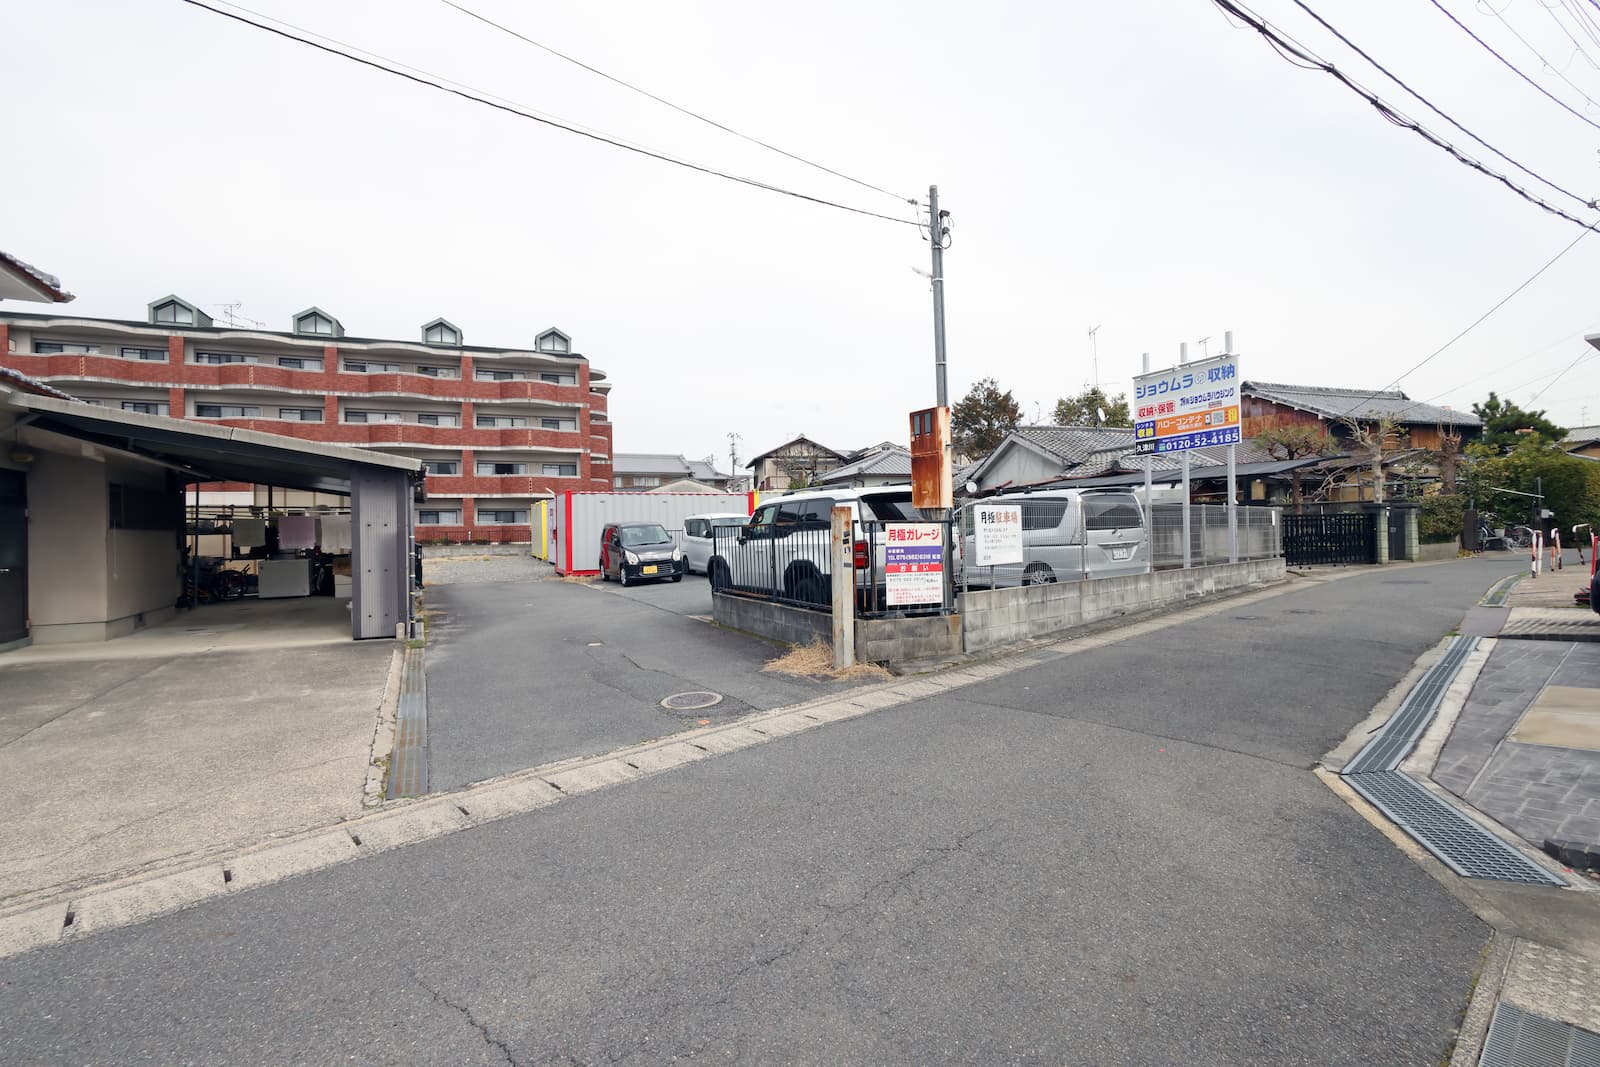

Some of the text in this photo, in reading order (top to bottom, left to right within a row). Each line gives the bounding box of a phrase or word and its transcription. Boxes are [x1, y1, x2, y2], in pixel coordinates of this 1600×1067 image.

[1138, 402, 1174, 417] 収納・保管
[1136, 422, 1154, 430] レンタル
[1157, 415, 1202, 429] ハローコンテナ
[1136, 443, 1155, 453] 久津川
[1166, 432, 1238, 450] 0120-52-4185
[981, 511, 1018, 525] 月極駐車場
[888, 528, 940, 541] 月極ガレージ
